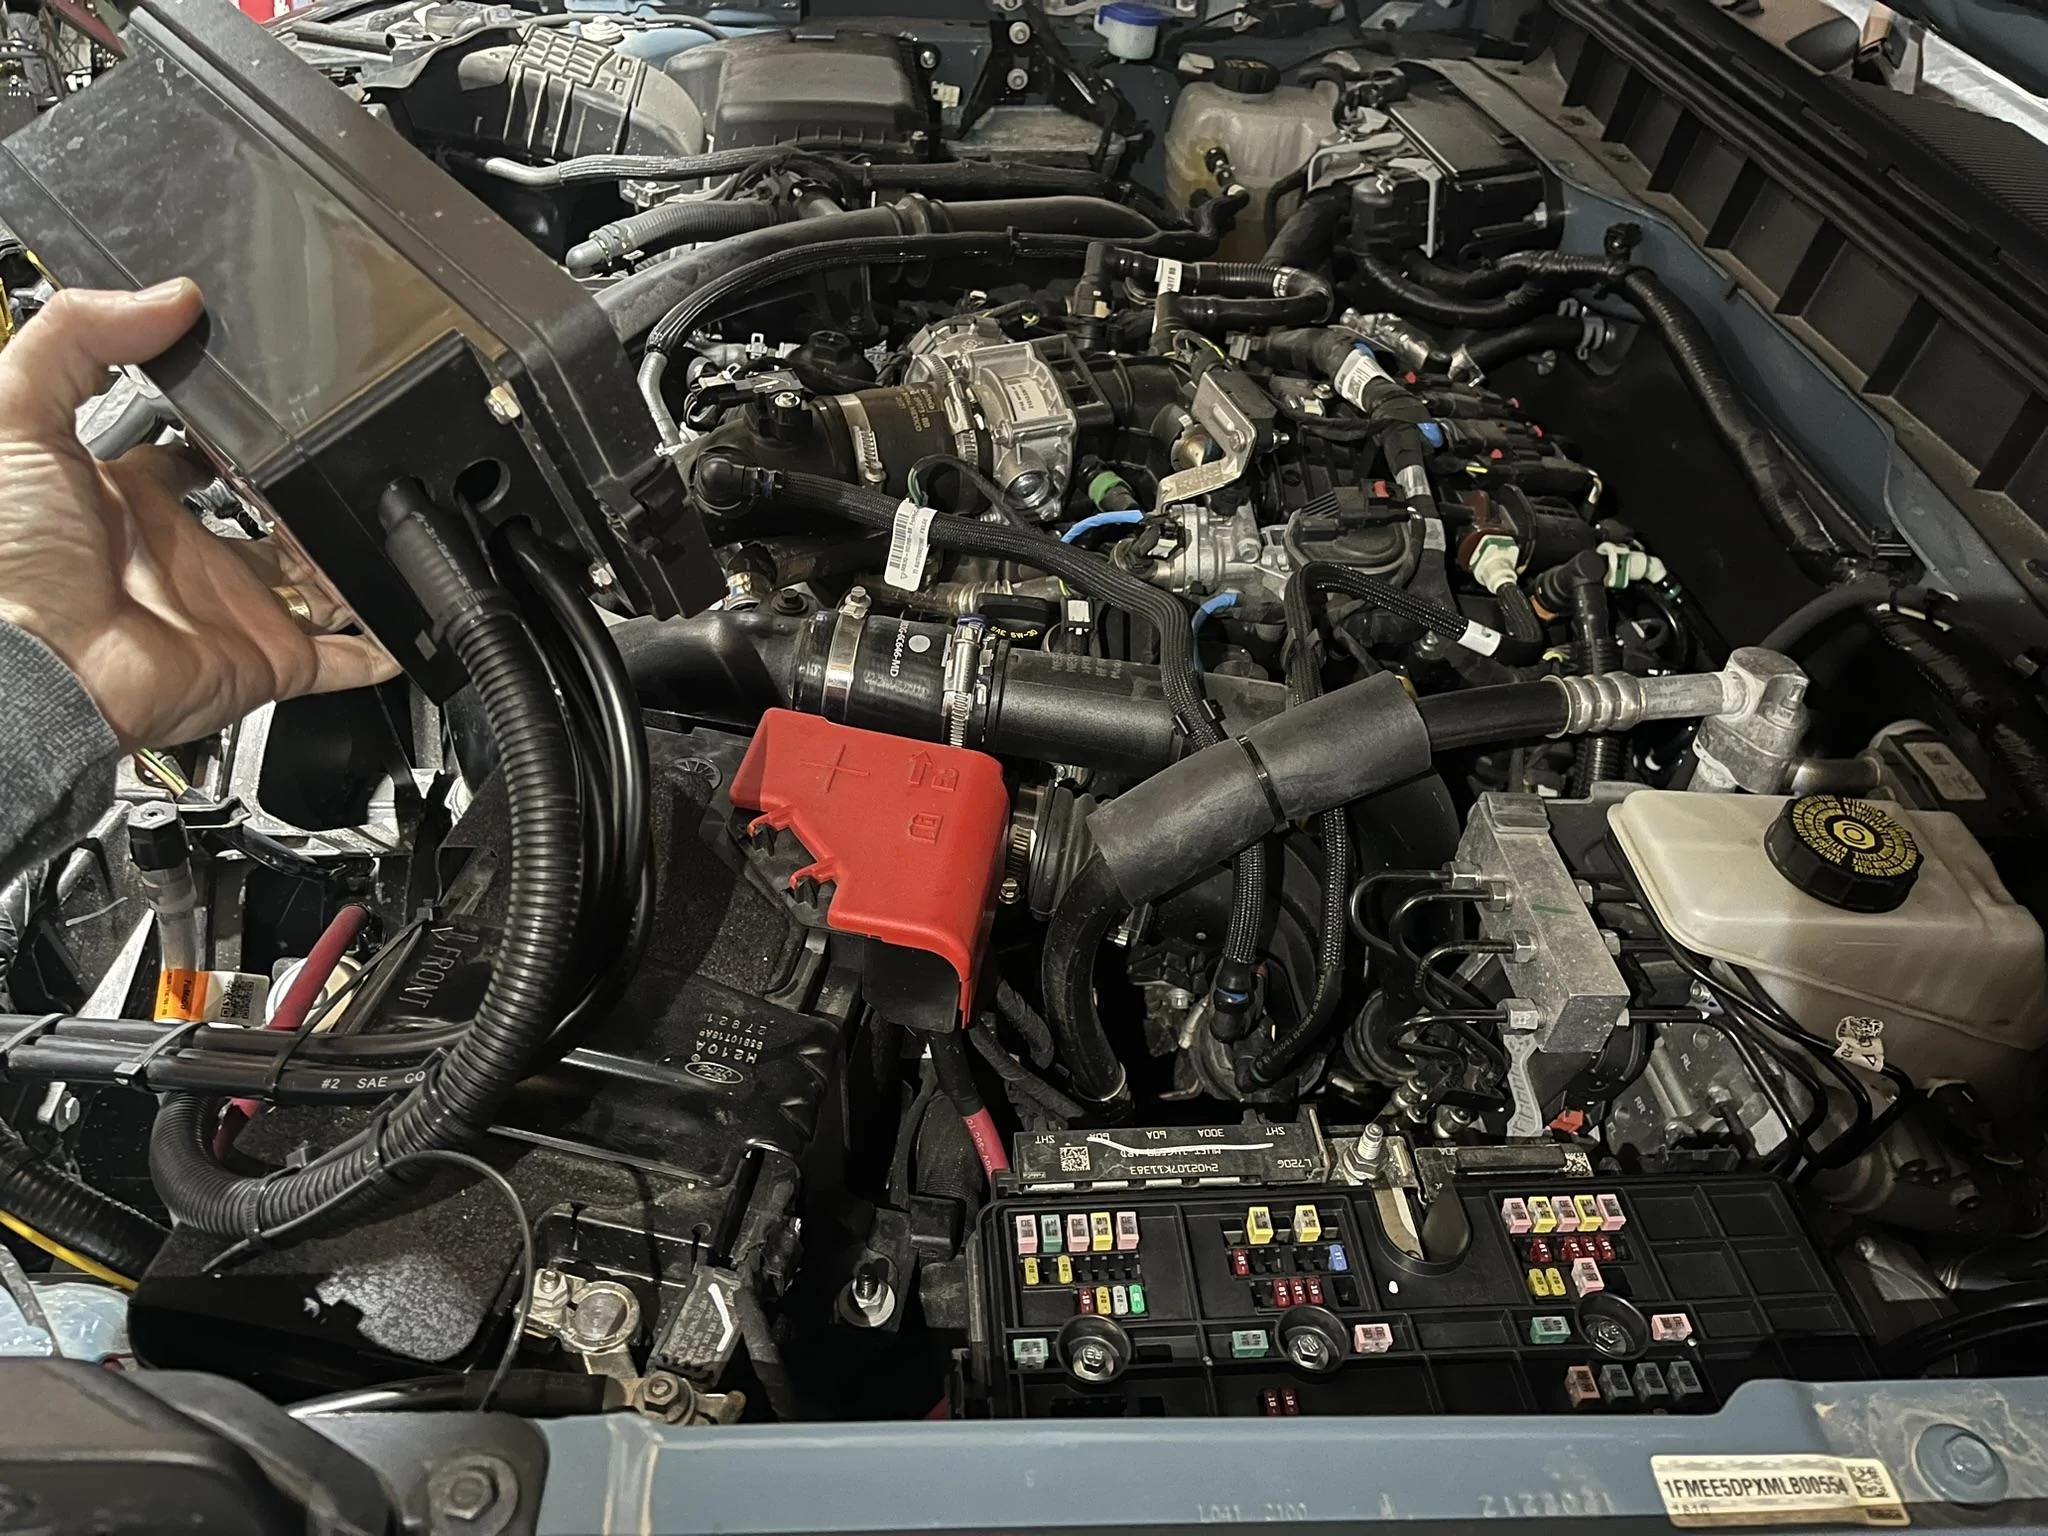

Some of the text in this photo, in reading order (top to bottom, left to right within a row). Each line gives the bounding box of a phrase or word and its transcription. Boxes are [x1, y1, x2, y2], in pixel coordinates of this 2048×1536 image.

[990, 625, 1007, 637] SAE
[399, 945, 462, 1008] FRONT
[696, 1040, 757, 1064] H210A
[321, 1078, 340, 1089] #2
[357, 1076, 388, 1089] SAE
[1634, 1096, 1646, 1115] RR
[966, 1117, 976, 1130] TO
[1146, 1129, 1167, 1139] 60A
[1199, 1128, 1224, 1138] 300A
[1266, 1126, 1285, 1136] SHT
[1035, 1135, 1055, 1144] SHT
[1538, 1243, 1548, 1253] 10
[1570, 1242, 1580, 1253] 10
[1586, 1242, 1595, 1252] 10
[1602, 1241, 1612, 1251] 10
[1237, 1255, 1246, 1265] 10
[1278, 1286, 1287, 1296] 10
[1294, 1285, 1304, 1296] 10
[1310, 1284, 1319, 1295] 10
[1267, 1396, 1277, 1407] 10
[1285, 1395, 1295, 1406] 10
[1664, 1476, 1849, 1499] 1FMEE5DPXMLB00554
